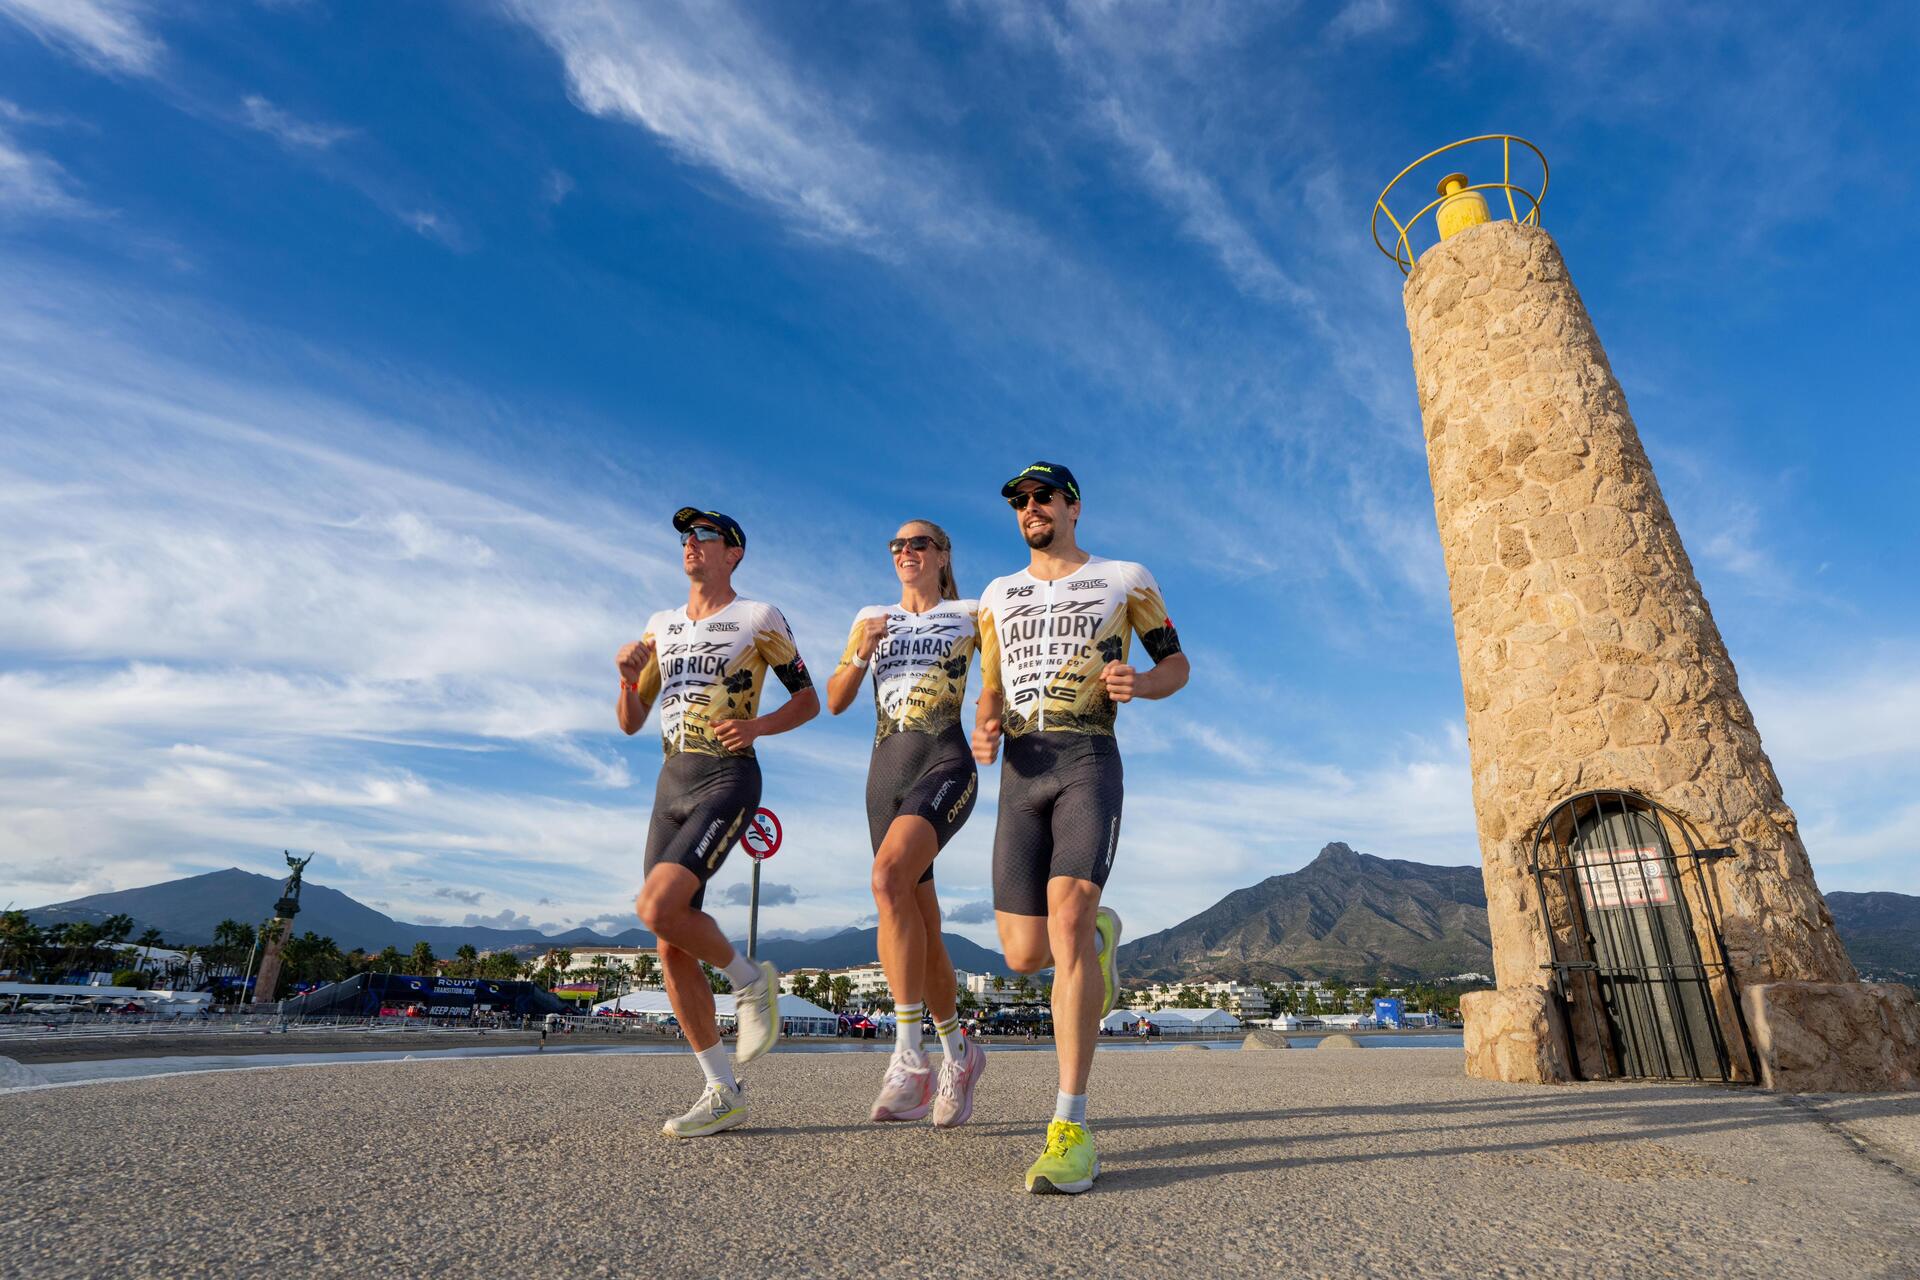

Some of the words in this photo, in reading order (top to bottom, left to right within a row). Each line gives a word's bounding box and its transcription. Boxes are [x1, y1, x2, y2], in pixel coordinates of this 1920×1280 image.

[1006, 589, 1033, 599] 70
[1001, 615, 1104, 648] LAUNDRY
[873, 638, 953, 663] BECHARAS
[1007, 643, 1092, 666] ATHLETIC
[661, 655, 731, 681] DUBRICK
[1018, 658, 1063, 670] BREWING
[1012, 670, 1087, 687] VENTUM
[888, 696, 926, 713] rythm
[429, 1006, 449, 1015] KEEP
